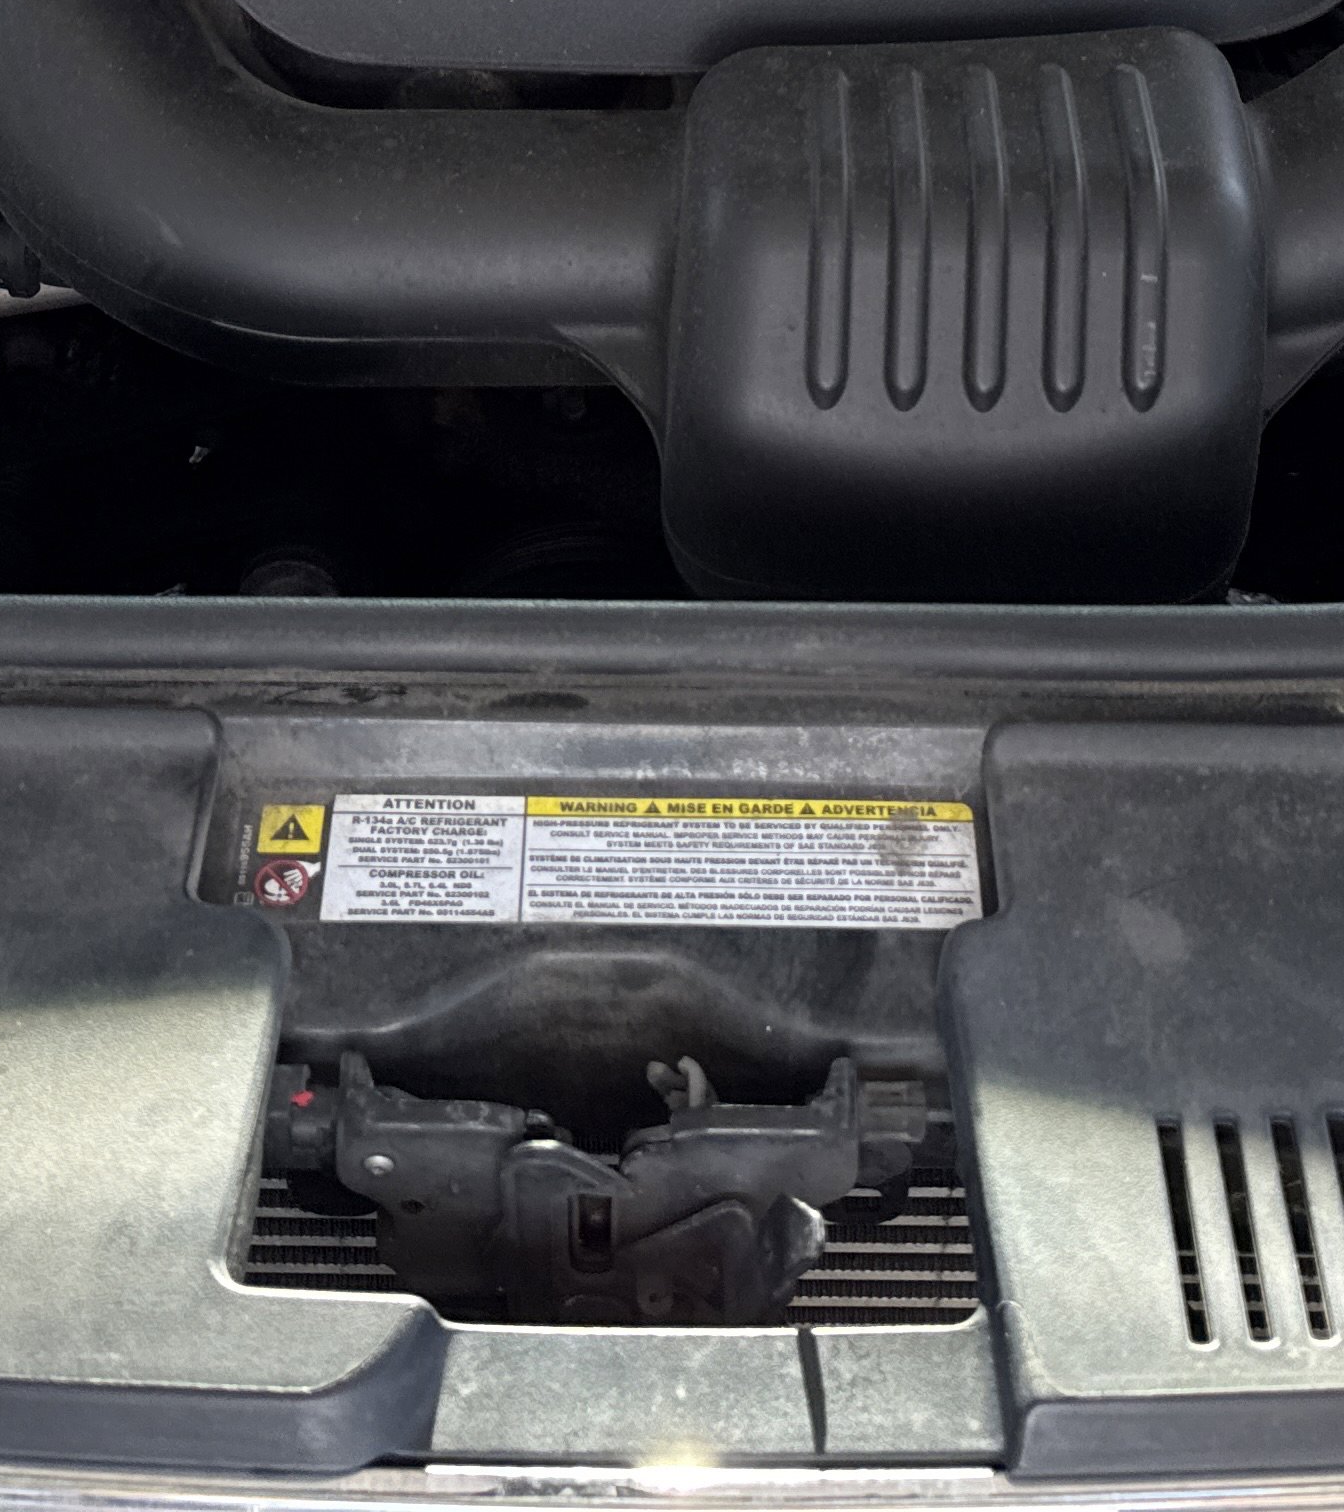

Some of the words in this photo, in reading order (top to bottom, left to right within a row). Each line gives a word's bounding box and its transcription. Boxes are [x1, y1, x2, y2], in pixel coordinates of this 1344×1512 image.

[383, 798, 475, 810] ATTENTION
[560, 802, 637, 814] WARNING
[667, 803, 706, 814] MISE
[712, 803, 733, 814] EN
[739, 804, 793, 815] GARDE
[352, 816, 392, 826] R-134a
[397, 816, 415, 826] A/C
[420, 816, 507, 827] REFRIGERANT
[371, 825, 427, 836] FACTORY
[432, 826, 487, 837] CHARGE:
[352, 846, 377, 854] DUAL
[370, 869, 455, 880] COMPRESSOR
[460, 870, 484, 880] OIL:
